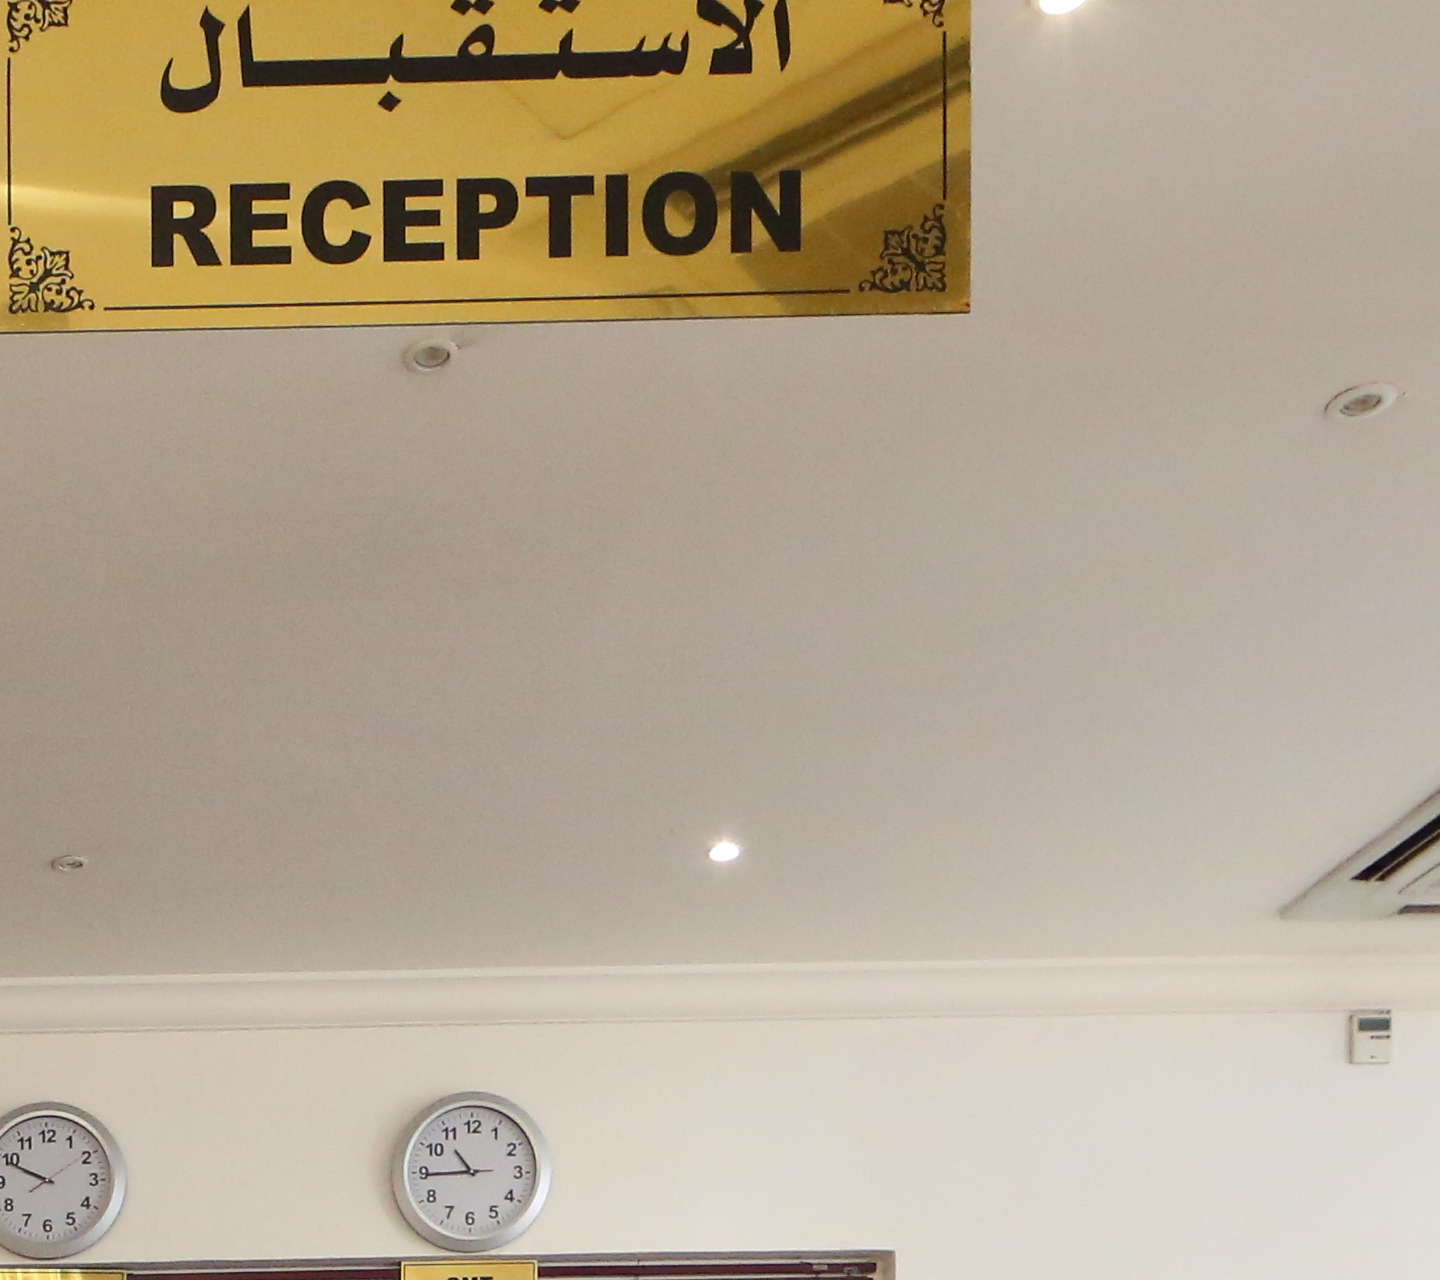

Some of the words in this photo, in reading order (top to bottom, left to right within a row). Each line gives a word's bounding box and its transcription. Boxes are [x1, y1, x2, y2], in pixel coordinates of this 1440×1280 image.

[149, 169, 803, 268] RECEPTION
[464, 1121, 481, 1133] 12
[39, 1130, 56, 1142] 12
[442, 1128, 457, 1140] 11
[491, 1128, 498, 1139] 1
[18, 1137, 32, 1149] 11
[67, 1137, 73, 1148] 1
[426, 1144, 443, 1156] 10
[507, 1144, 516, 1156] 2
[3, 1153, 19, 1165] 10
[82, 1151, 91, 1164] 2
[420, 1166, 428, 1179] 9
[514, 1166, 522, 1179] 3
[90, 1173, 98, 1186] 3
[427, 1190, 436, 1202] 8
[504, 1190, 513, 1202] 4
[4, 1199, 13, 1211] 8
[81, 1197, 90, 1209] 4
[66, 1212, 75, 1225] 5
[445, 1206, 454, 1219] 7
[465, 1212, 475, 1225] 6
[489, 1206, 498, 1219] 5
[22, 1214, 31, 1226] 7
[43, 1220, 52, 1232] 6
